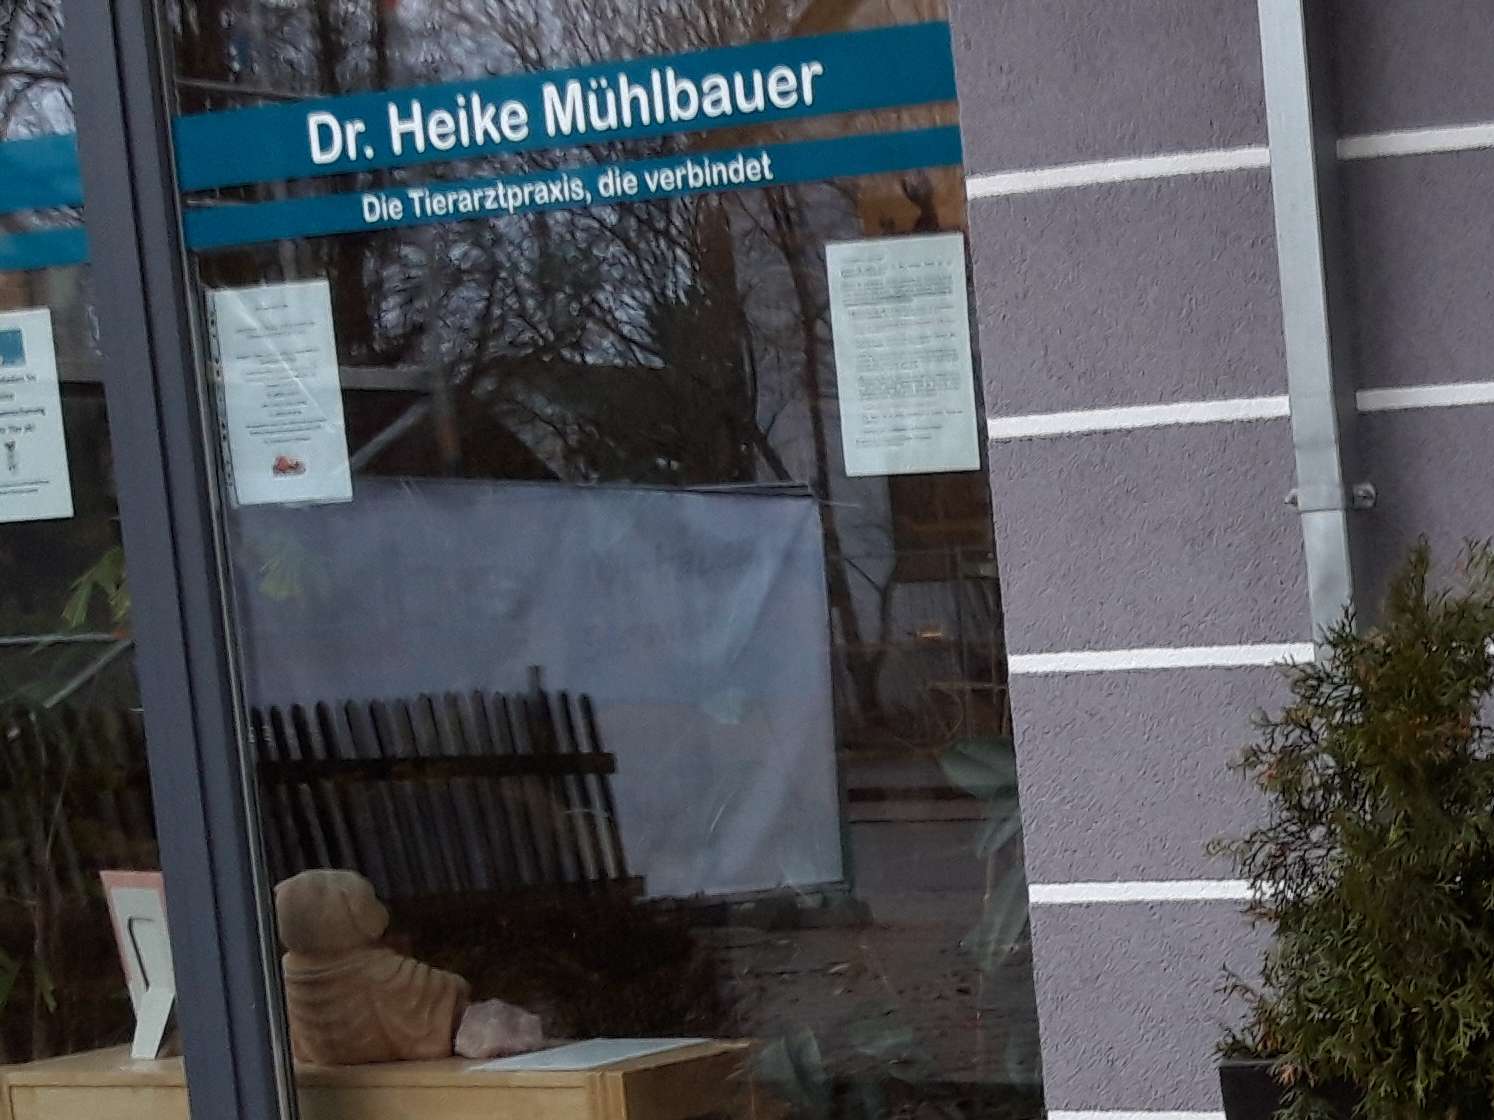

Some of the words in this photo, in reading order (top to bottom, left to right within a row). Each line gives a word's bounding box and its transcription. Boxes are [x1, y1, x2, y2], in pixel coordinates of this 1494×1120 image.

[306, 110, 375, 164] Dr.
[387, 91, 530, 156] Heike
[541, 60, 824, 137] Mühlbauer
[362, 192, 404, 223] Die
[408, 172, 593, 214] Tierarztpraxis,
[598, 166, 639, 198] die
[643, 150, 774, 193] verbindet
